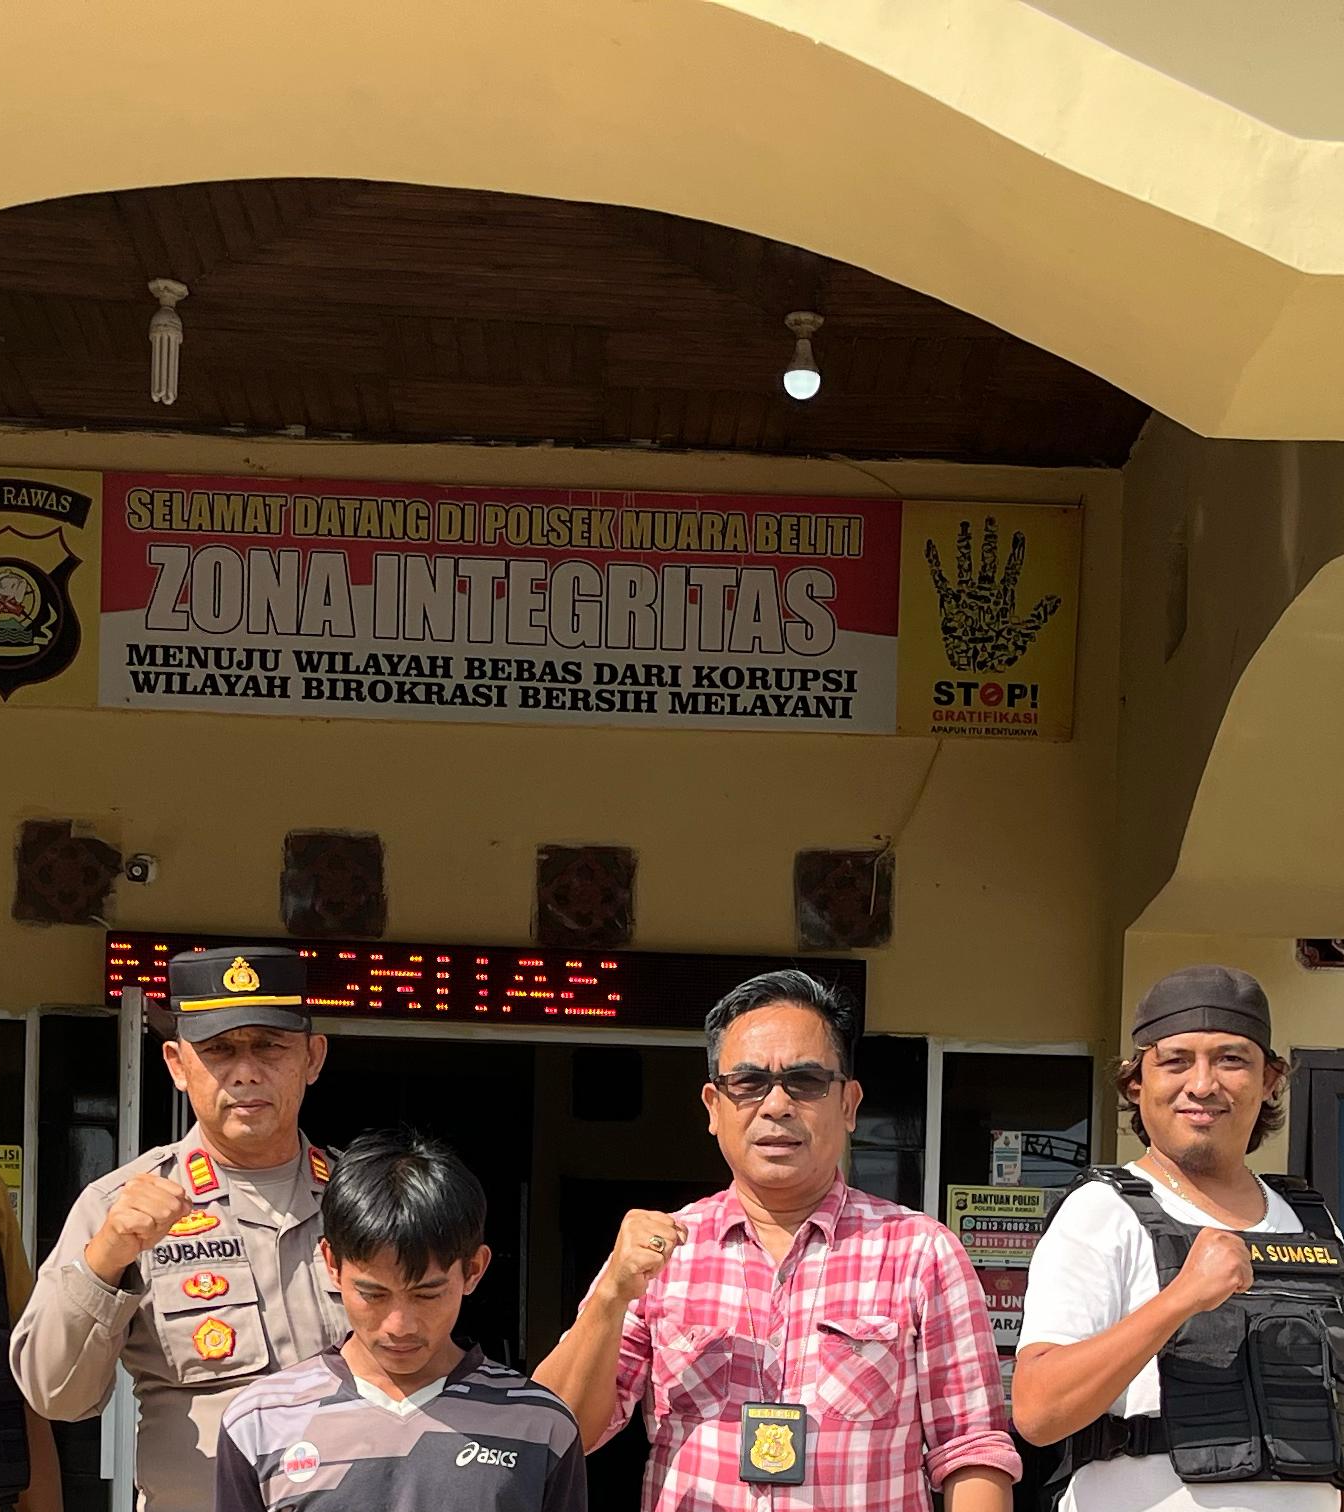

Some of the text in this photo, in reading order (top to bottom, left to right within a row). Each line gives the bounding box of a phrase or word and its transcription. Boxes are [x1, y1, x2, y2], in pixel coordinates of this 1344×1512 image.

[2, 486, 74, 515] RAWAS
[126, 489, 863, 558] SELAMAT DATANG DI POLSEK MUARA BELITI
[144, 544, 837, 657] ZONA INTEGRITAS
[126, 643, 859, 695] MENUJU WILAYAH BEBAS DARI KORUPSI
[129, 670, 854, 720] WILAYAH BIROKRASI BERSIH MELAYANI
[932, 680, 1040, 709] STOP!
[930, 725, 1038, 737] APAPUN ITU BENTUKNYA
[932, 709, 1038, 724] GRATIFIKASI
[971, 1194, 1040, 1206] BANTUAN POLISI
[154, 1238, 241, 1265] SUBARDI
[1265, 1244, 1338, 1265] SUMSEL
